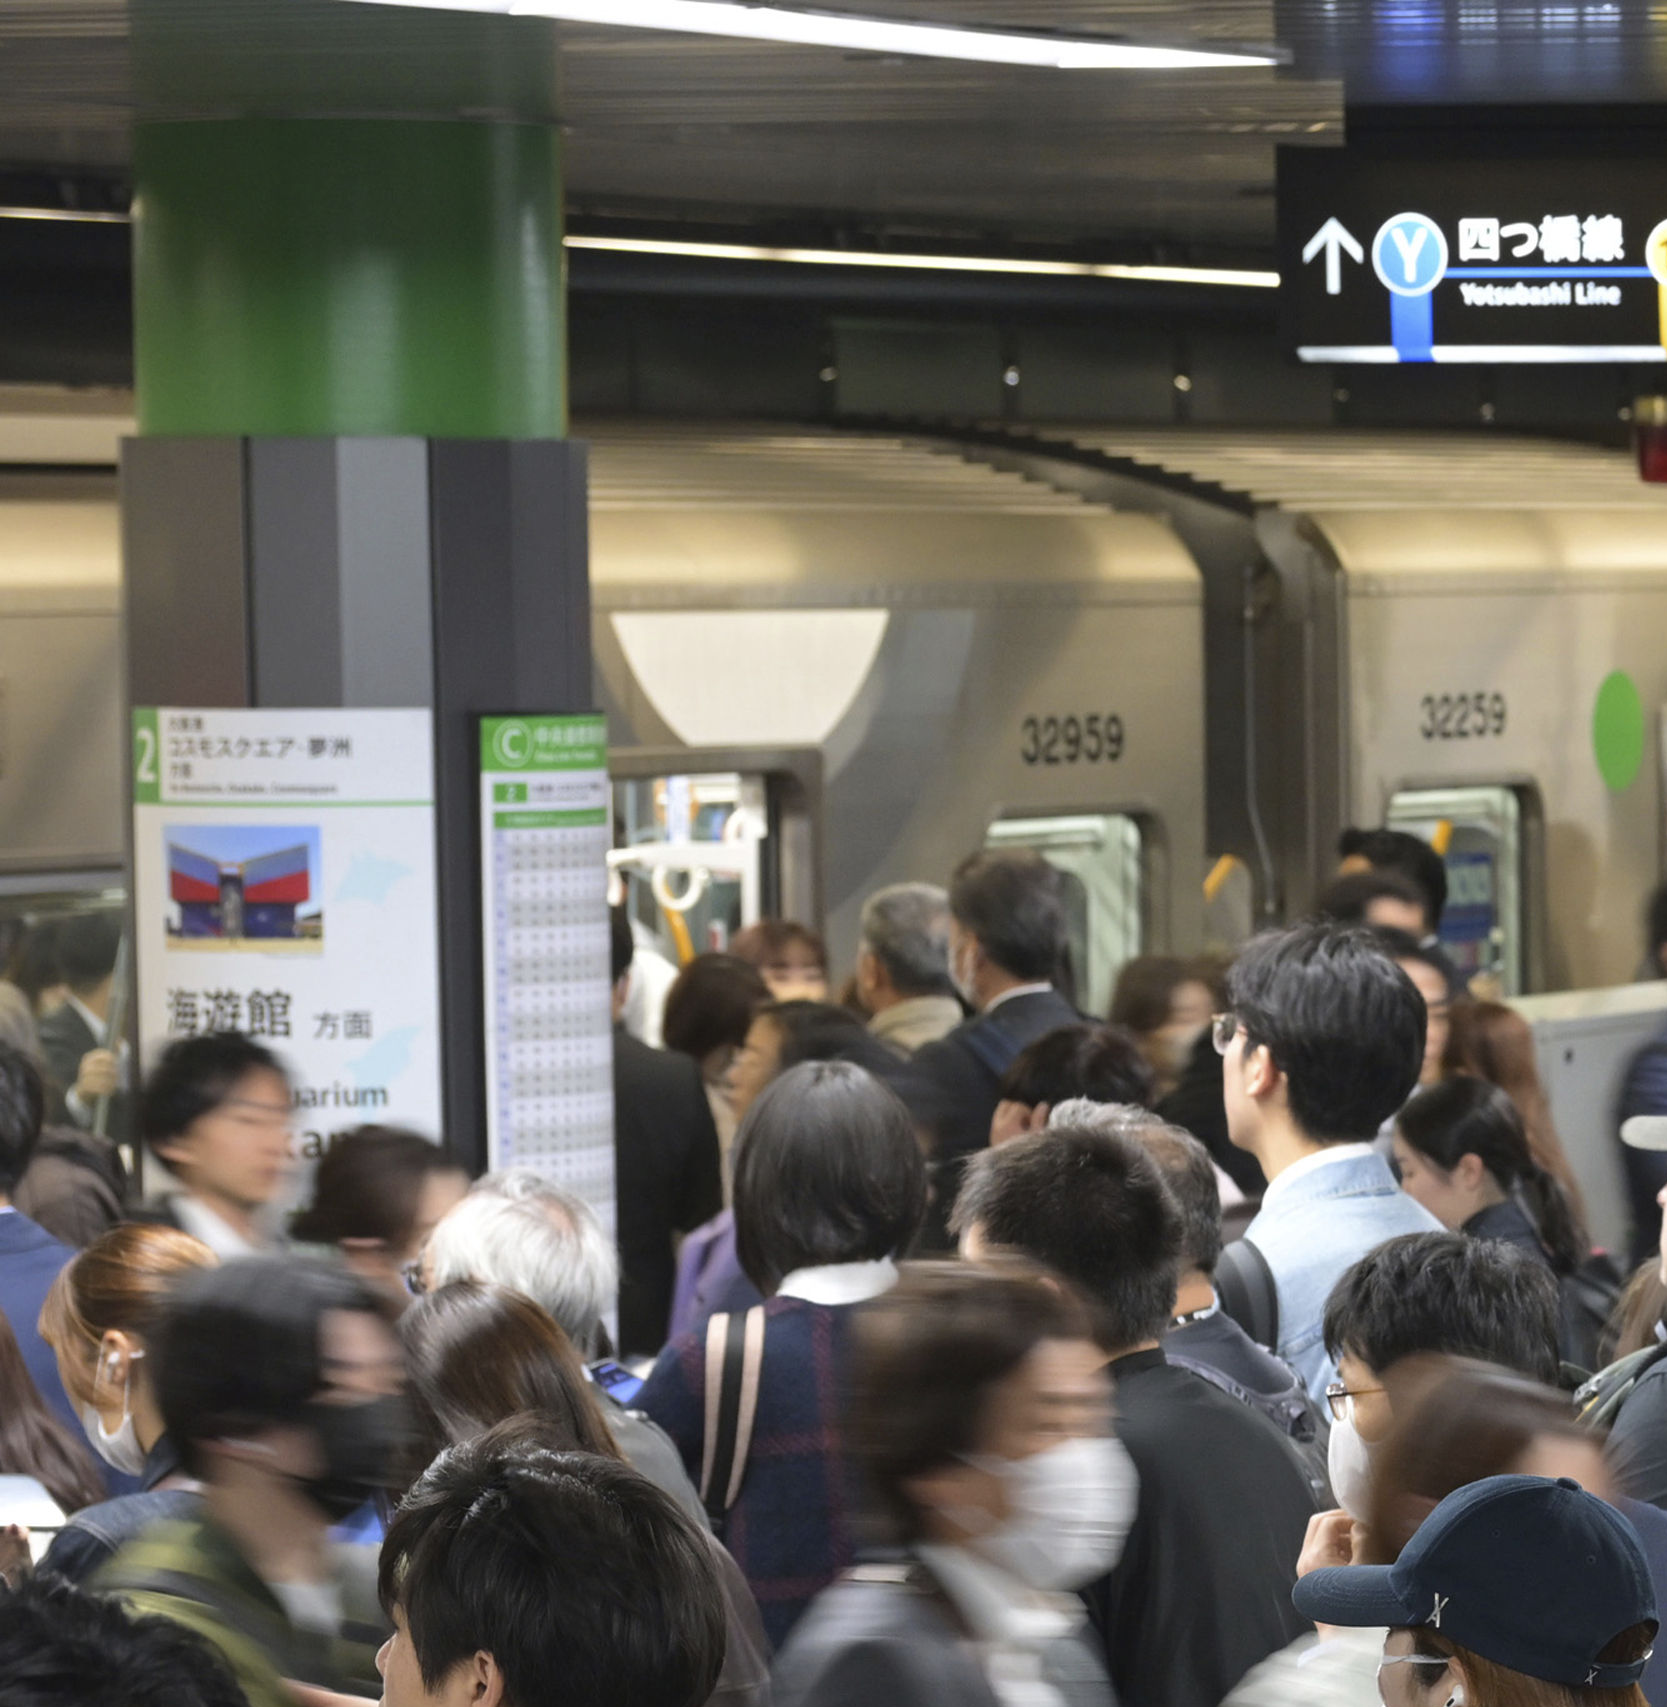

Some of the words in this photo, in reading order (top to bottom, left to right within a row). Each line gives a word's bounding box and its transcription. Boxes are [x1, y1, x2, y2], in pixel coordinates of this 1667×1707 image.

[1392, 227, 1428, 283] Y
[1575, 281, 1622, 306] Line
[1021, 713, 1125, 765] 32959
[1420, 692, 1508, 740] 32259
[136, 727, 157, 783] 2
[167, 987, 292, 1038] 海遊館
[313, 1009, 374, 1040] 方面
